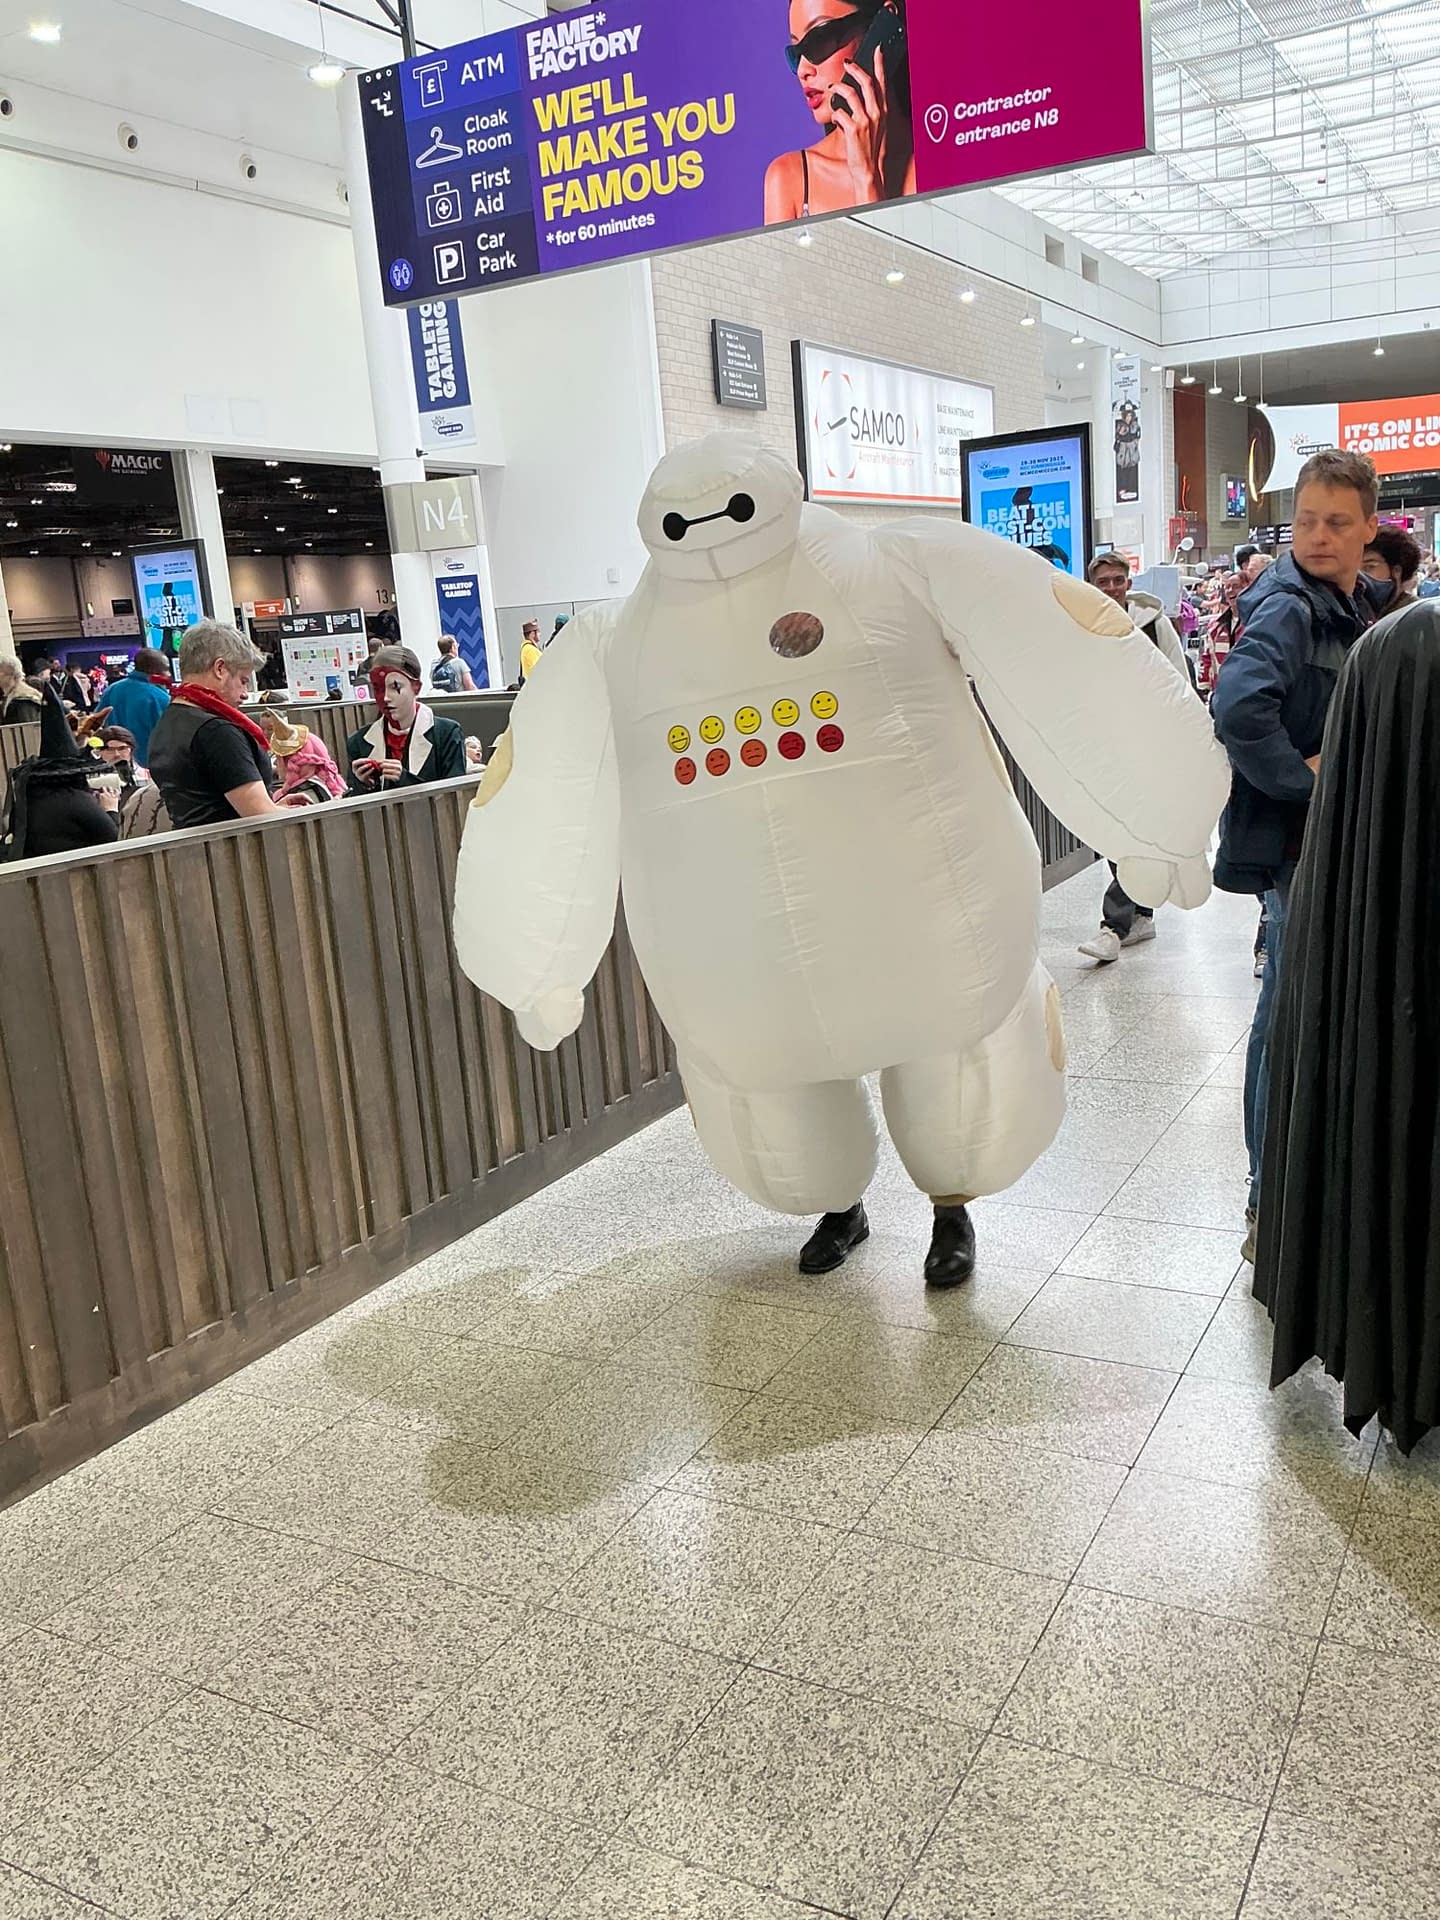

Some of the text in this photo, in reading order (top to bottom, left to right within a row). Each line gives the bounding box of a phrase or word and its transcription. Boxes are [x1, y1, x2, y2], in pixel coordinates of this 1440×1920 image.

[528, 24, 643, 80] FACTORY
[460, 53, 505, 85] ATM
[532, 71, 648, 133] WE'LL
[953, 85, 1052, 121] Contractor
[464, 108, 509, 135] Cloak
[954, 108, 1060, 146] entrance N8
[466, 131, 513, 157] Room
[537, 92, 737, 178] MAKE YOU
[471, 166, 512, 194] First
[541, 150, 706, 222] FAMOUS
[474, 191, 505, 217] Aid
[577, 222, 597, 241] 60
[598, 211, 656, 239] minutes
[476, 231, 507, 251] Car
[479, 250, 518, 275] Park
[433, 300, 457, 399] GAMING
[849, 406, 905, 446] SAMCO
[1344, 422, 1380, 440] IT'S
[1382, 418, 1412, 436] ON
[1346, 434, 1410, 454] COMIC
[111, 454, 163, 470] MAGIC
[423, 496, 469, 532] N4
[987, 500, 1065, 524] BEAT THE
[376, 588, 389, 605] 13
[441, 581, 474, 591] TABLETOP
[444, 589, 472, 598] GAMING
[149, 593, 194, 609] BEAT THE
[159, 615, 190, 627] BLUES
